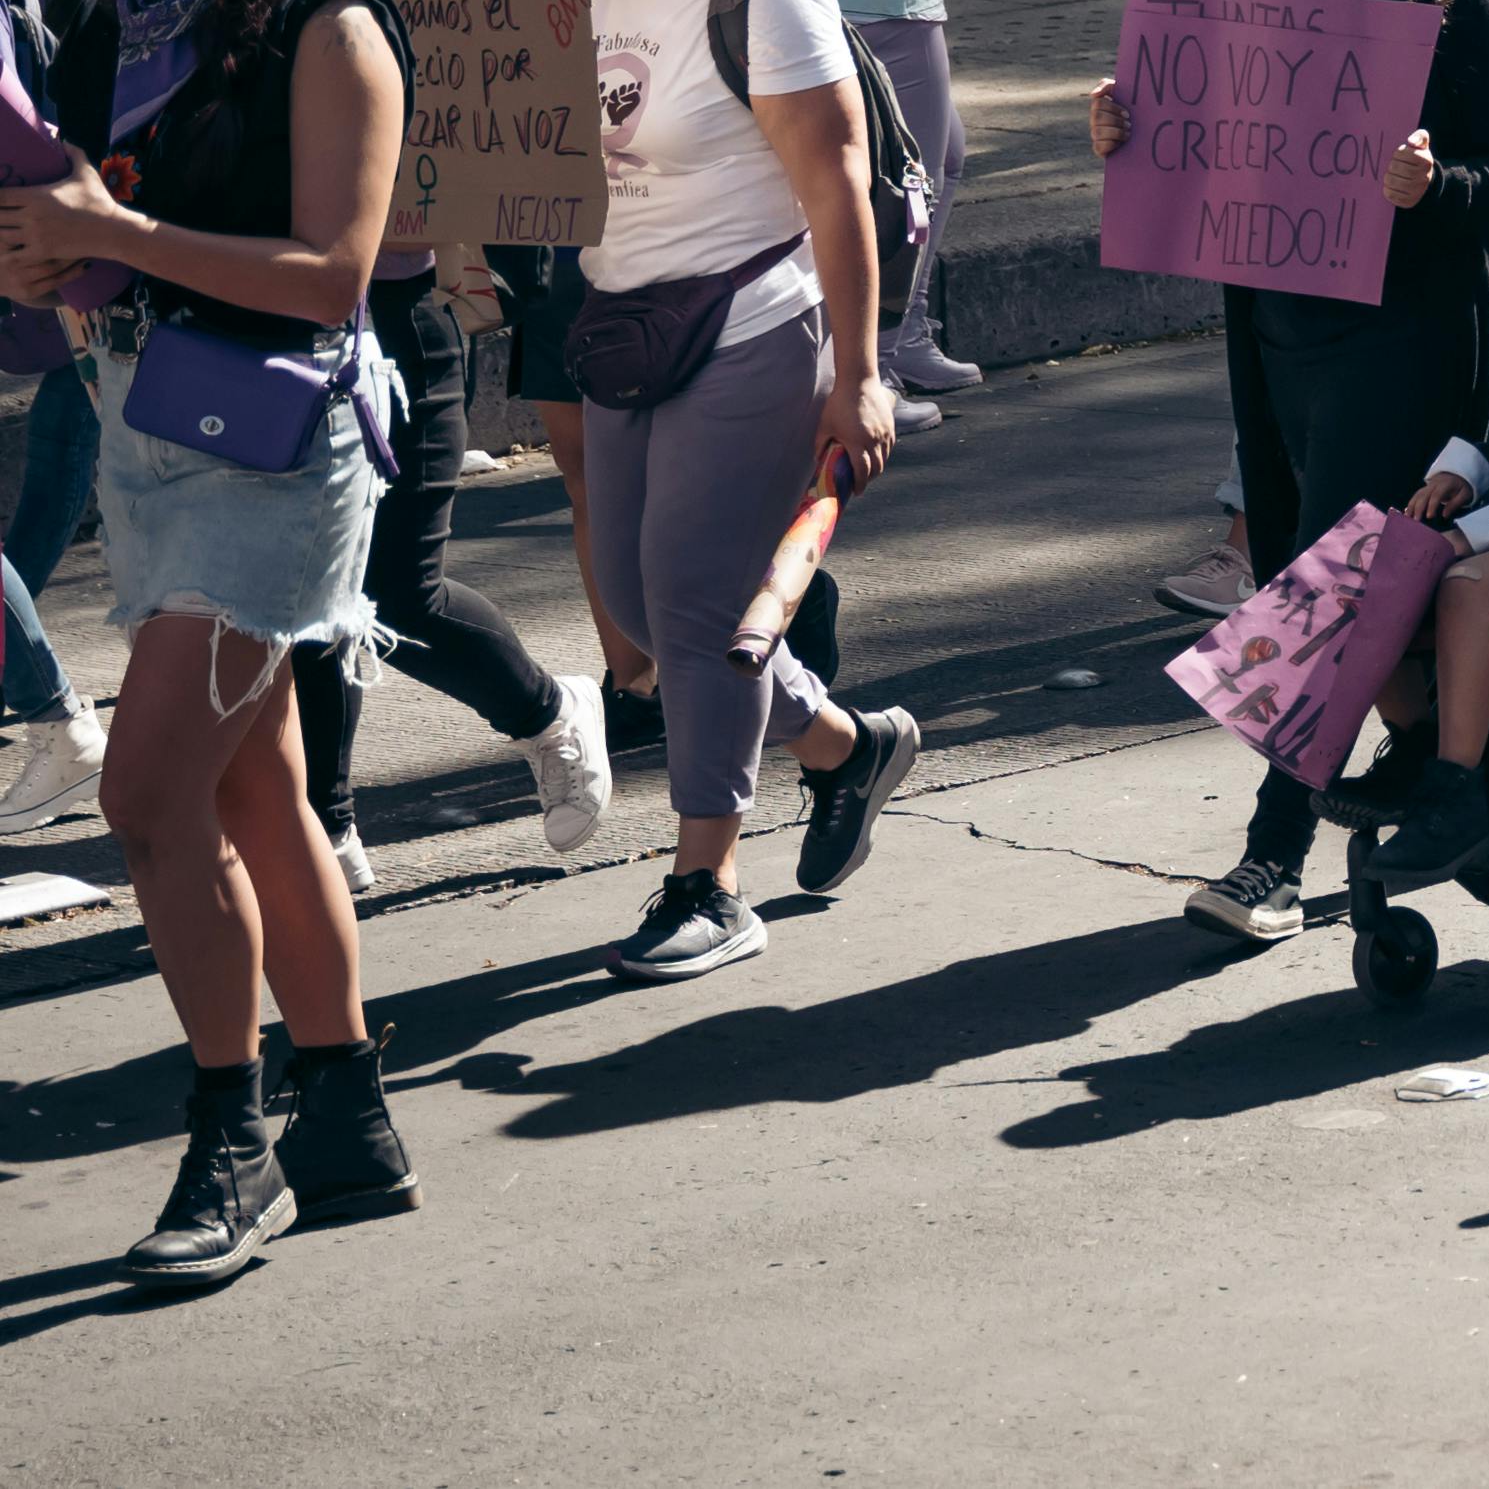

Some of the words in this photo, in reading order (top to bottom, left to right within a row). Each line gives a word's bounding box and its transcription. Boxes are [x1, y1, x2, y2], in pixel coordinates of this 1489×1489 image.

[1131, 33, 1208, 107] NO
[1228, 43, 1314, 107] VOY
[1331, 50, 1370, 112] A
[512, 106, 588, 156] VOZ
[1151, 119, 1294, 175] CRECER
[1308, 130, 1384, 181] CON
[394, 211, 424, 237] 8M
[1196, 197, 1356, 269] MIEDO!!
